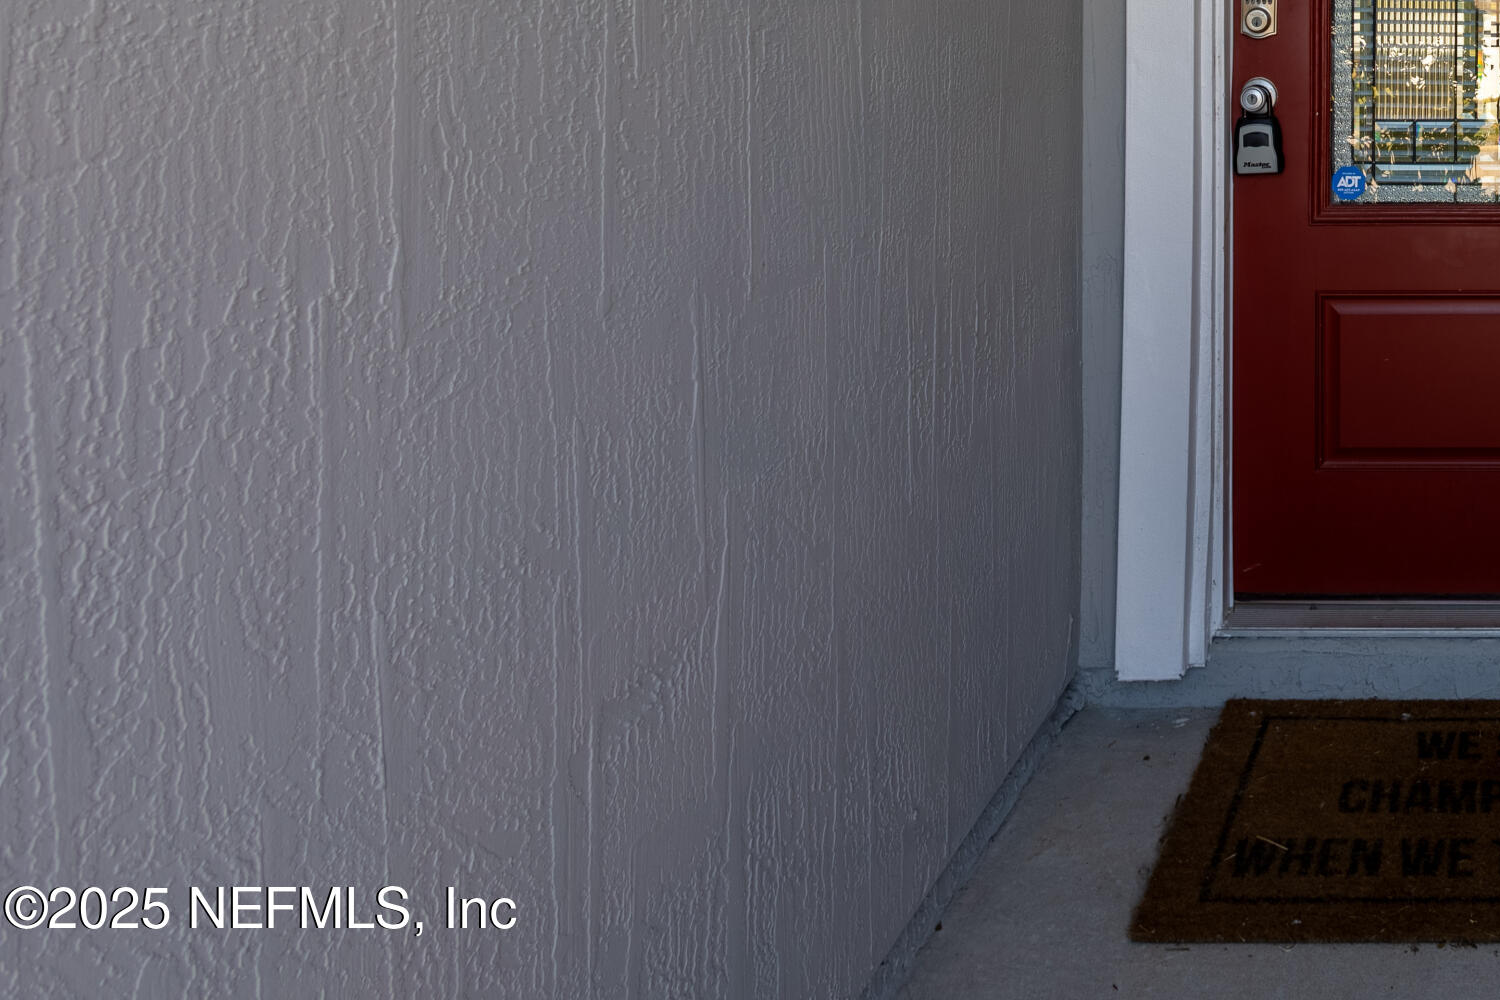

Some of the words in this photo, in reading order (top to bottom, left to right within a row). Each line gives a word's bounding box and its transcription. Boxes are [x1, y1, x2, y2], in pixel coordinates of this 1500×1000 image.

[1336, 175, 1362, 188] ADT
[1417, 731, 1482, 760] WE
[1232, 838, 1383, 877] WHEN
[1401, 838, 1474, 877] WE
